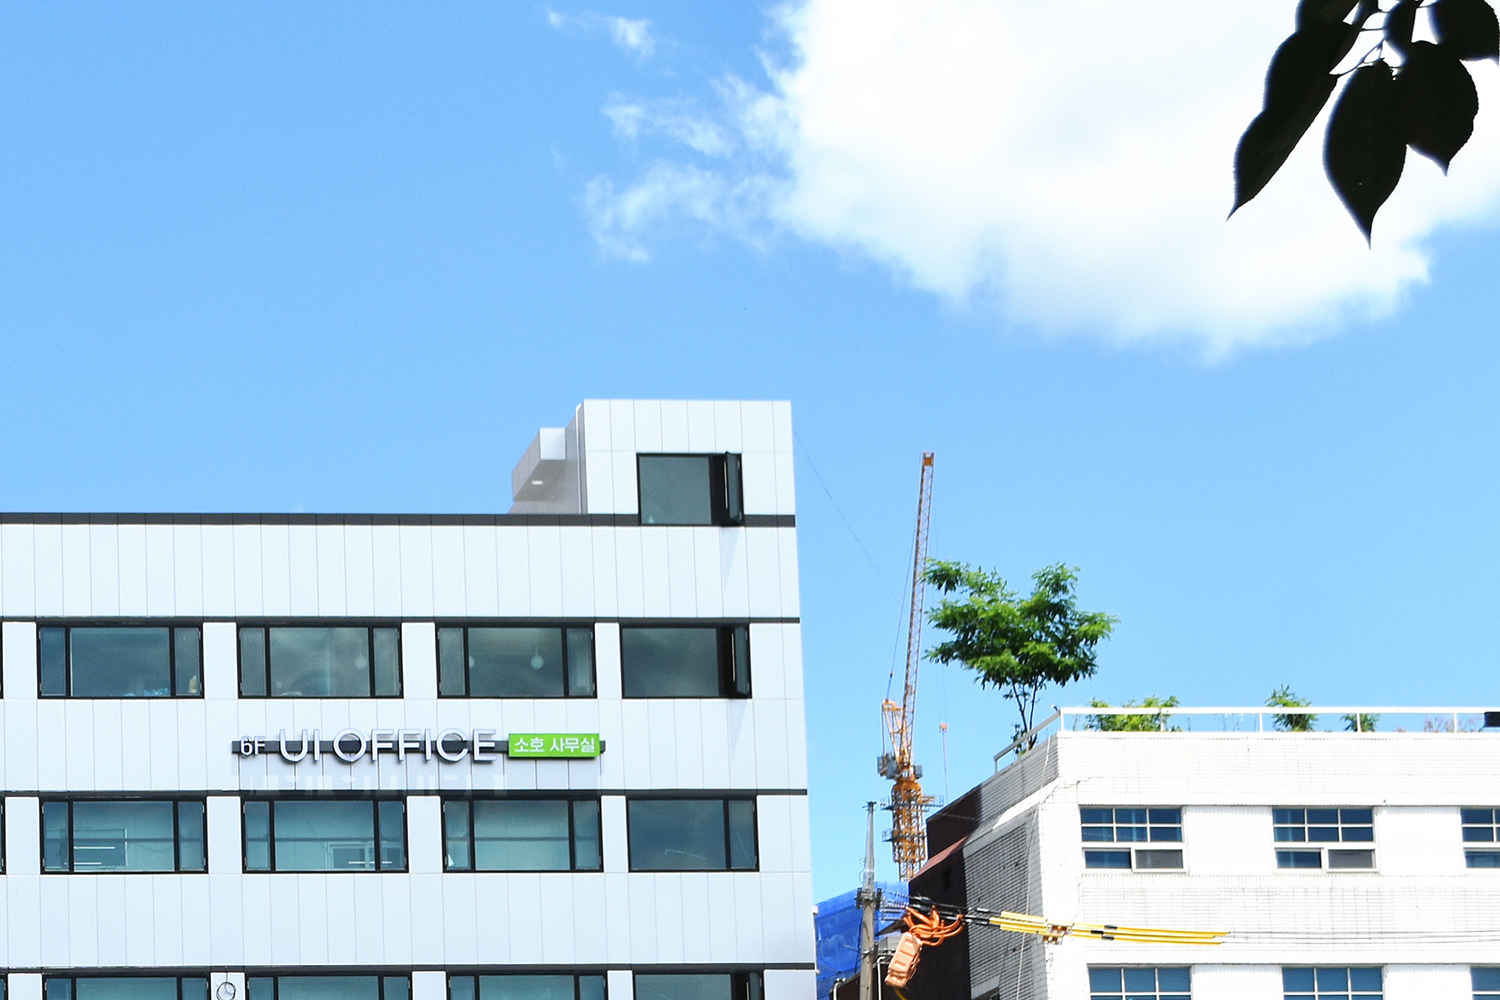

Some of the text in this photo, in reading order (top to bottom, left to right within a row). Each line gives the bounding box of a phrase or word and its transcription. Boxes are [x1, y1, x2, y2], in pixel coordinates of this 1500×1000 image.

[241, 728, 496, 763] 6F UI OFFICE
[514, 737, 595, 753] 소호 사무실
